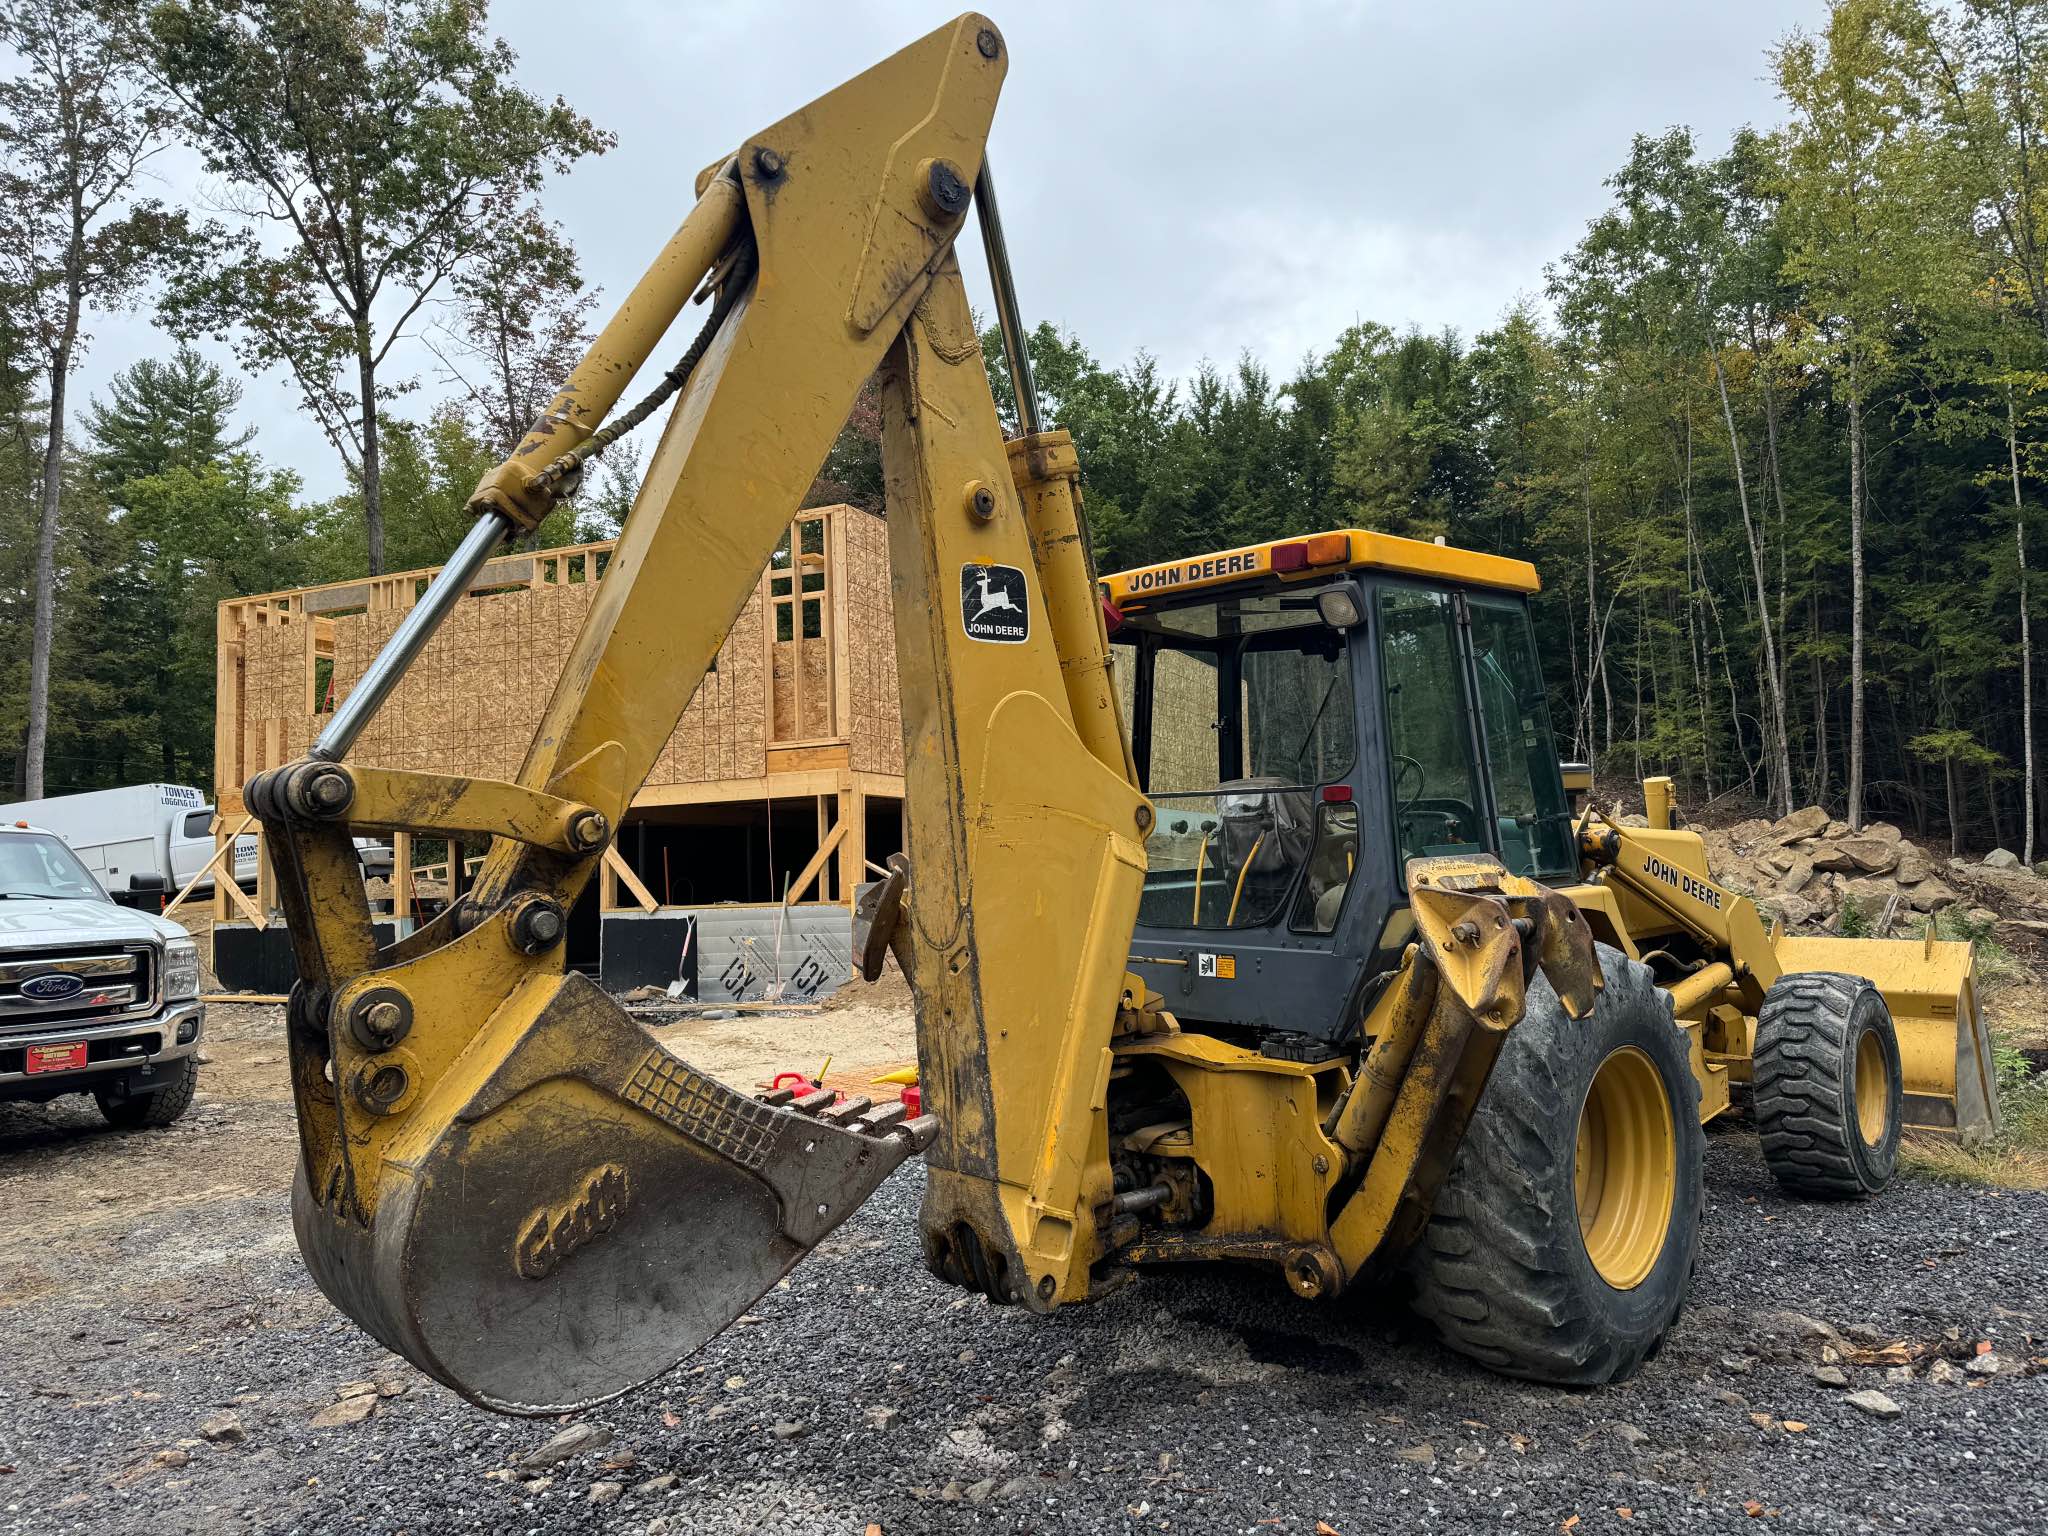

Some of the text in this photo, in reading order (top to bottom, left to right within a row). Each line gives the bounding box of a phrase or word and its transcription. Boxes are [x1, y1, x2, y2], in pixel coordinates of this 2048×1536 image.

[1130, 552, 1255, 592] JOHN DEERE
[968, 623, 1025, 636] JOHN DEERE
[161, 796, 188, 807] LOGGING
[1643, 855, 1721, 910] JOHN DEERE
[36, 979, 71, 993] Ford
